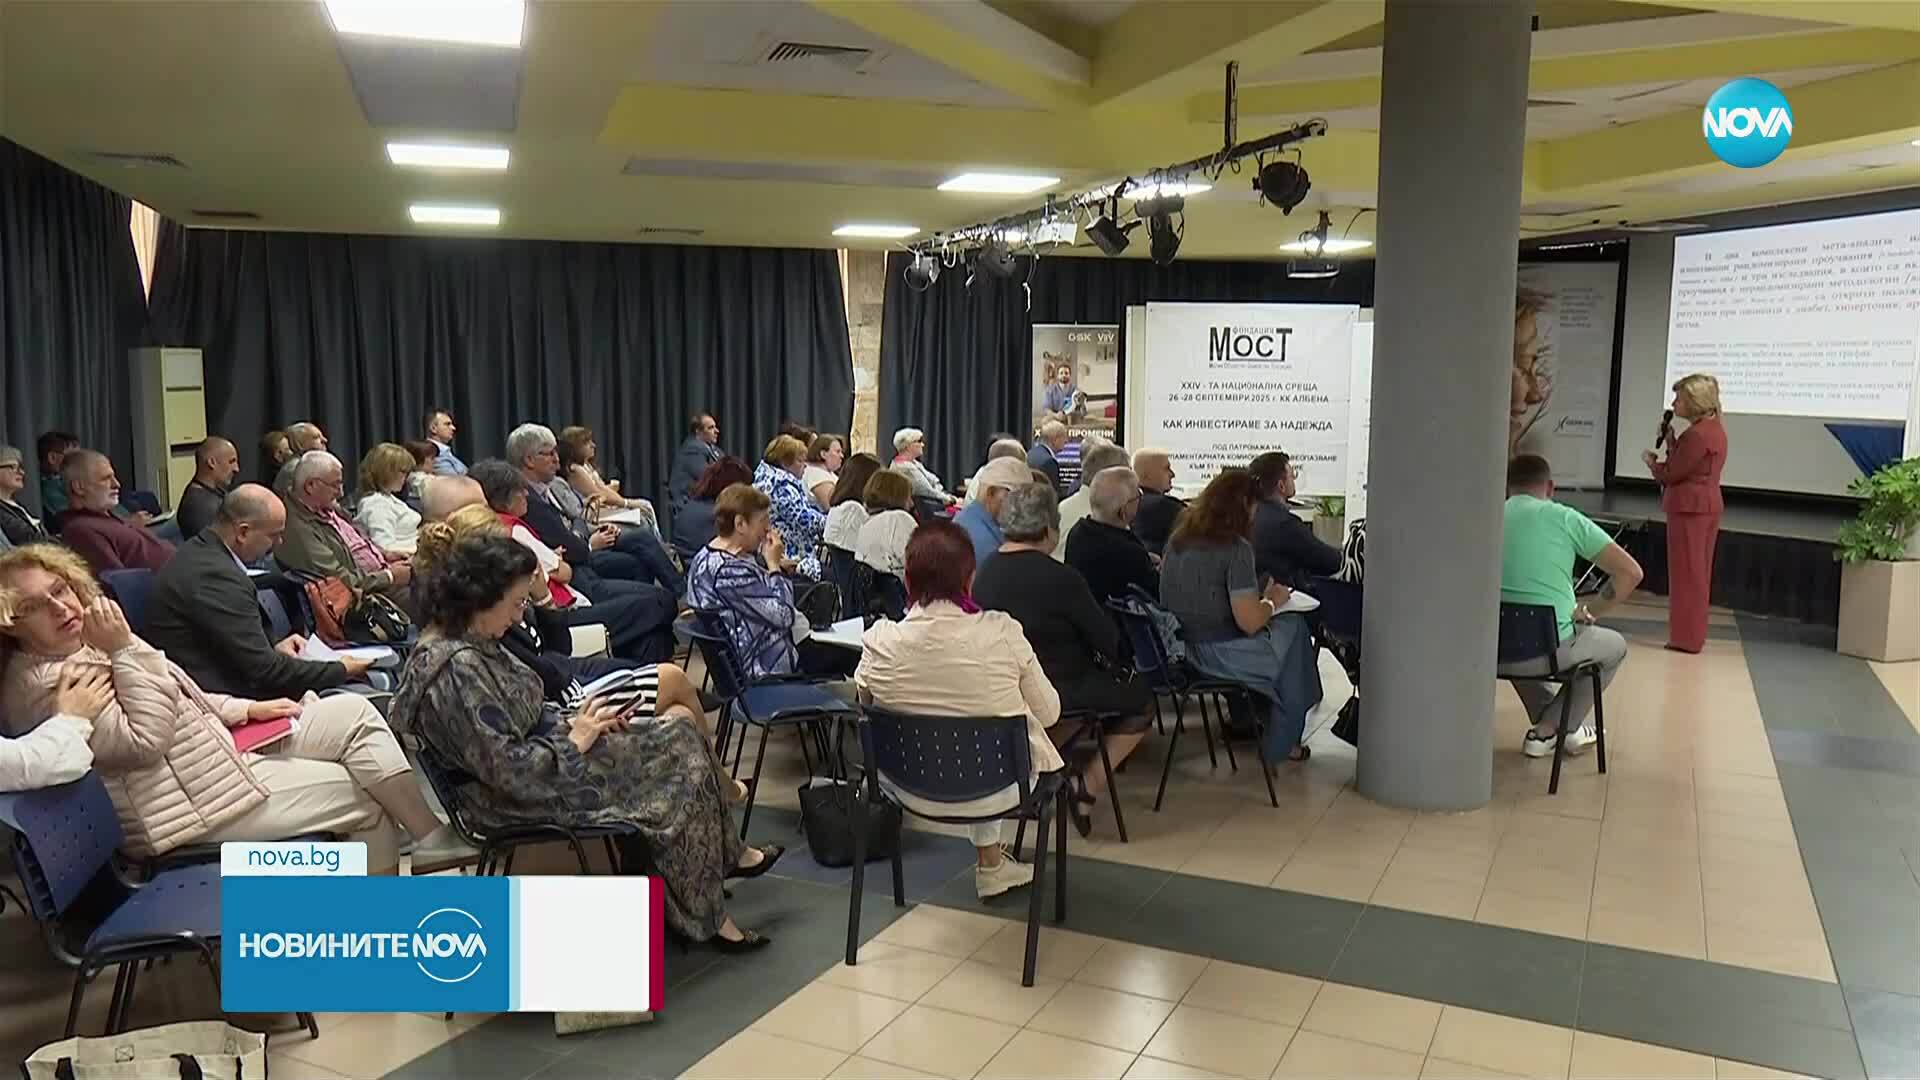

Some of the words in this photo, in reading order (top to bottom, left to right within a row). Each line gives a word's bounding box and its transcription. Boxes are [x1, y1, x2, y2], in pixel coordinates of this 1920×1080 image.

[1209, 382, 1220, 390] ТА
[1222, 382, 1283, 391] НАЦИОНАЛНА
[1285, 383, 1318, 392] СРЕЩА
[1168, 393, 1179, 401] 26
[1292, 395, 1330, 403] АЛБЕНА
[1162, 419, 1183, 429] КАК
[1263, 420, 1278, 430] ЗА
[1280, 420, 1333, 431] НАДЕЖДА
